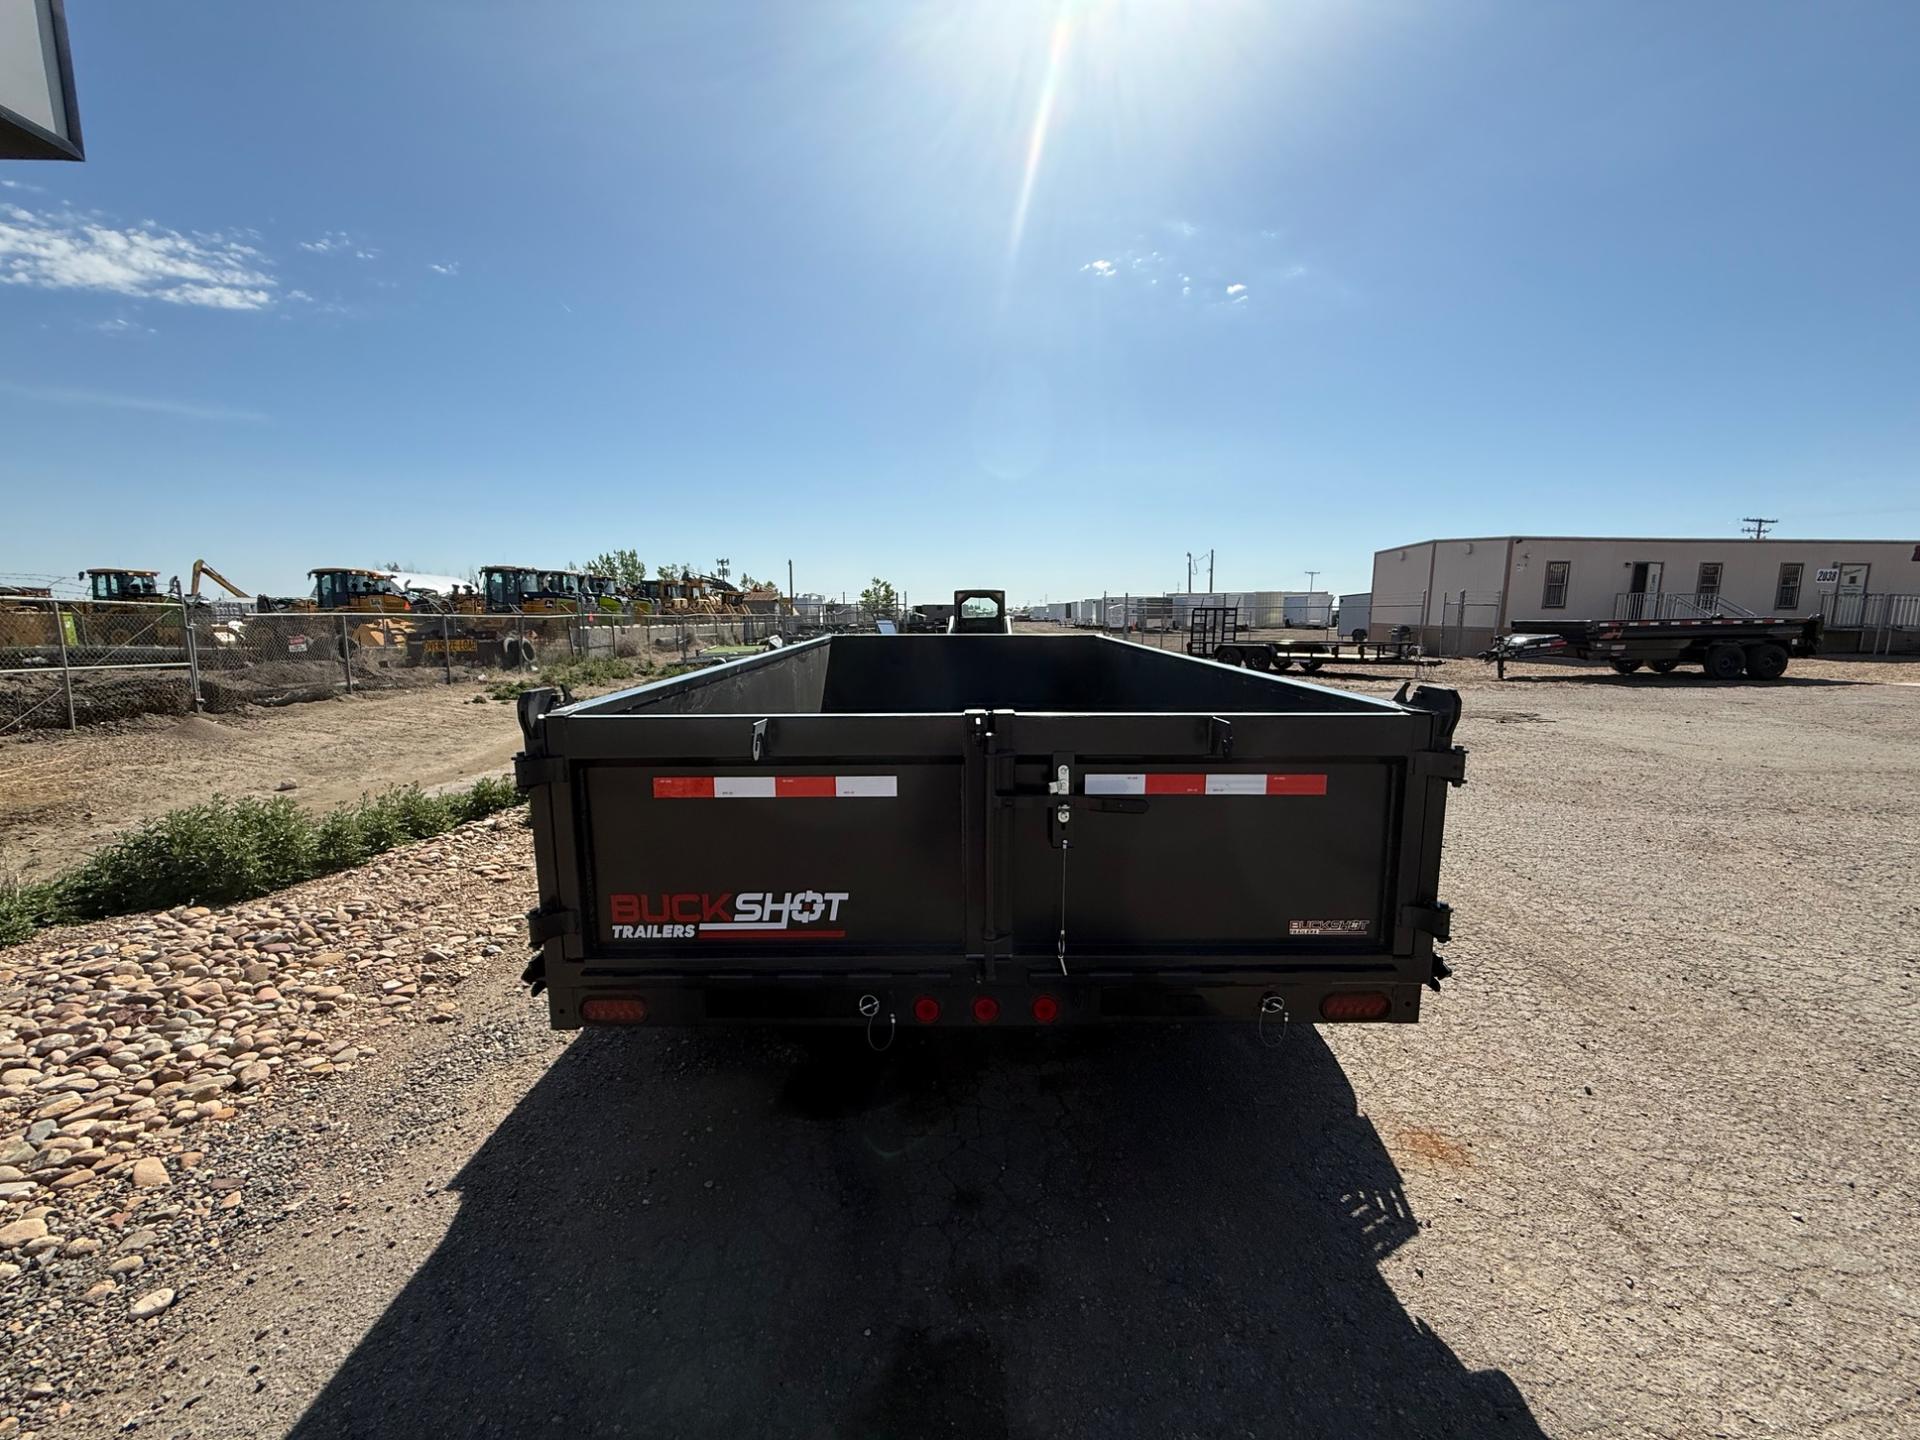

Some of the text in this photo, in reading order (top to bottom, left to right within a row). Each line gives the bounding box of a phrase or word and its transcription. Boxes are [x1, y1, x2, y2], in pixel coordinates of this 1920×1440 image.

[424, 640, 457, 652] OVERSZE
[610, 891, 849, 924] BUCKSHOT
[612, 924, 696, 939] TRAILERS
[1289, 920, 1370, 930] BUCKSHOT
